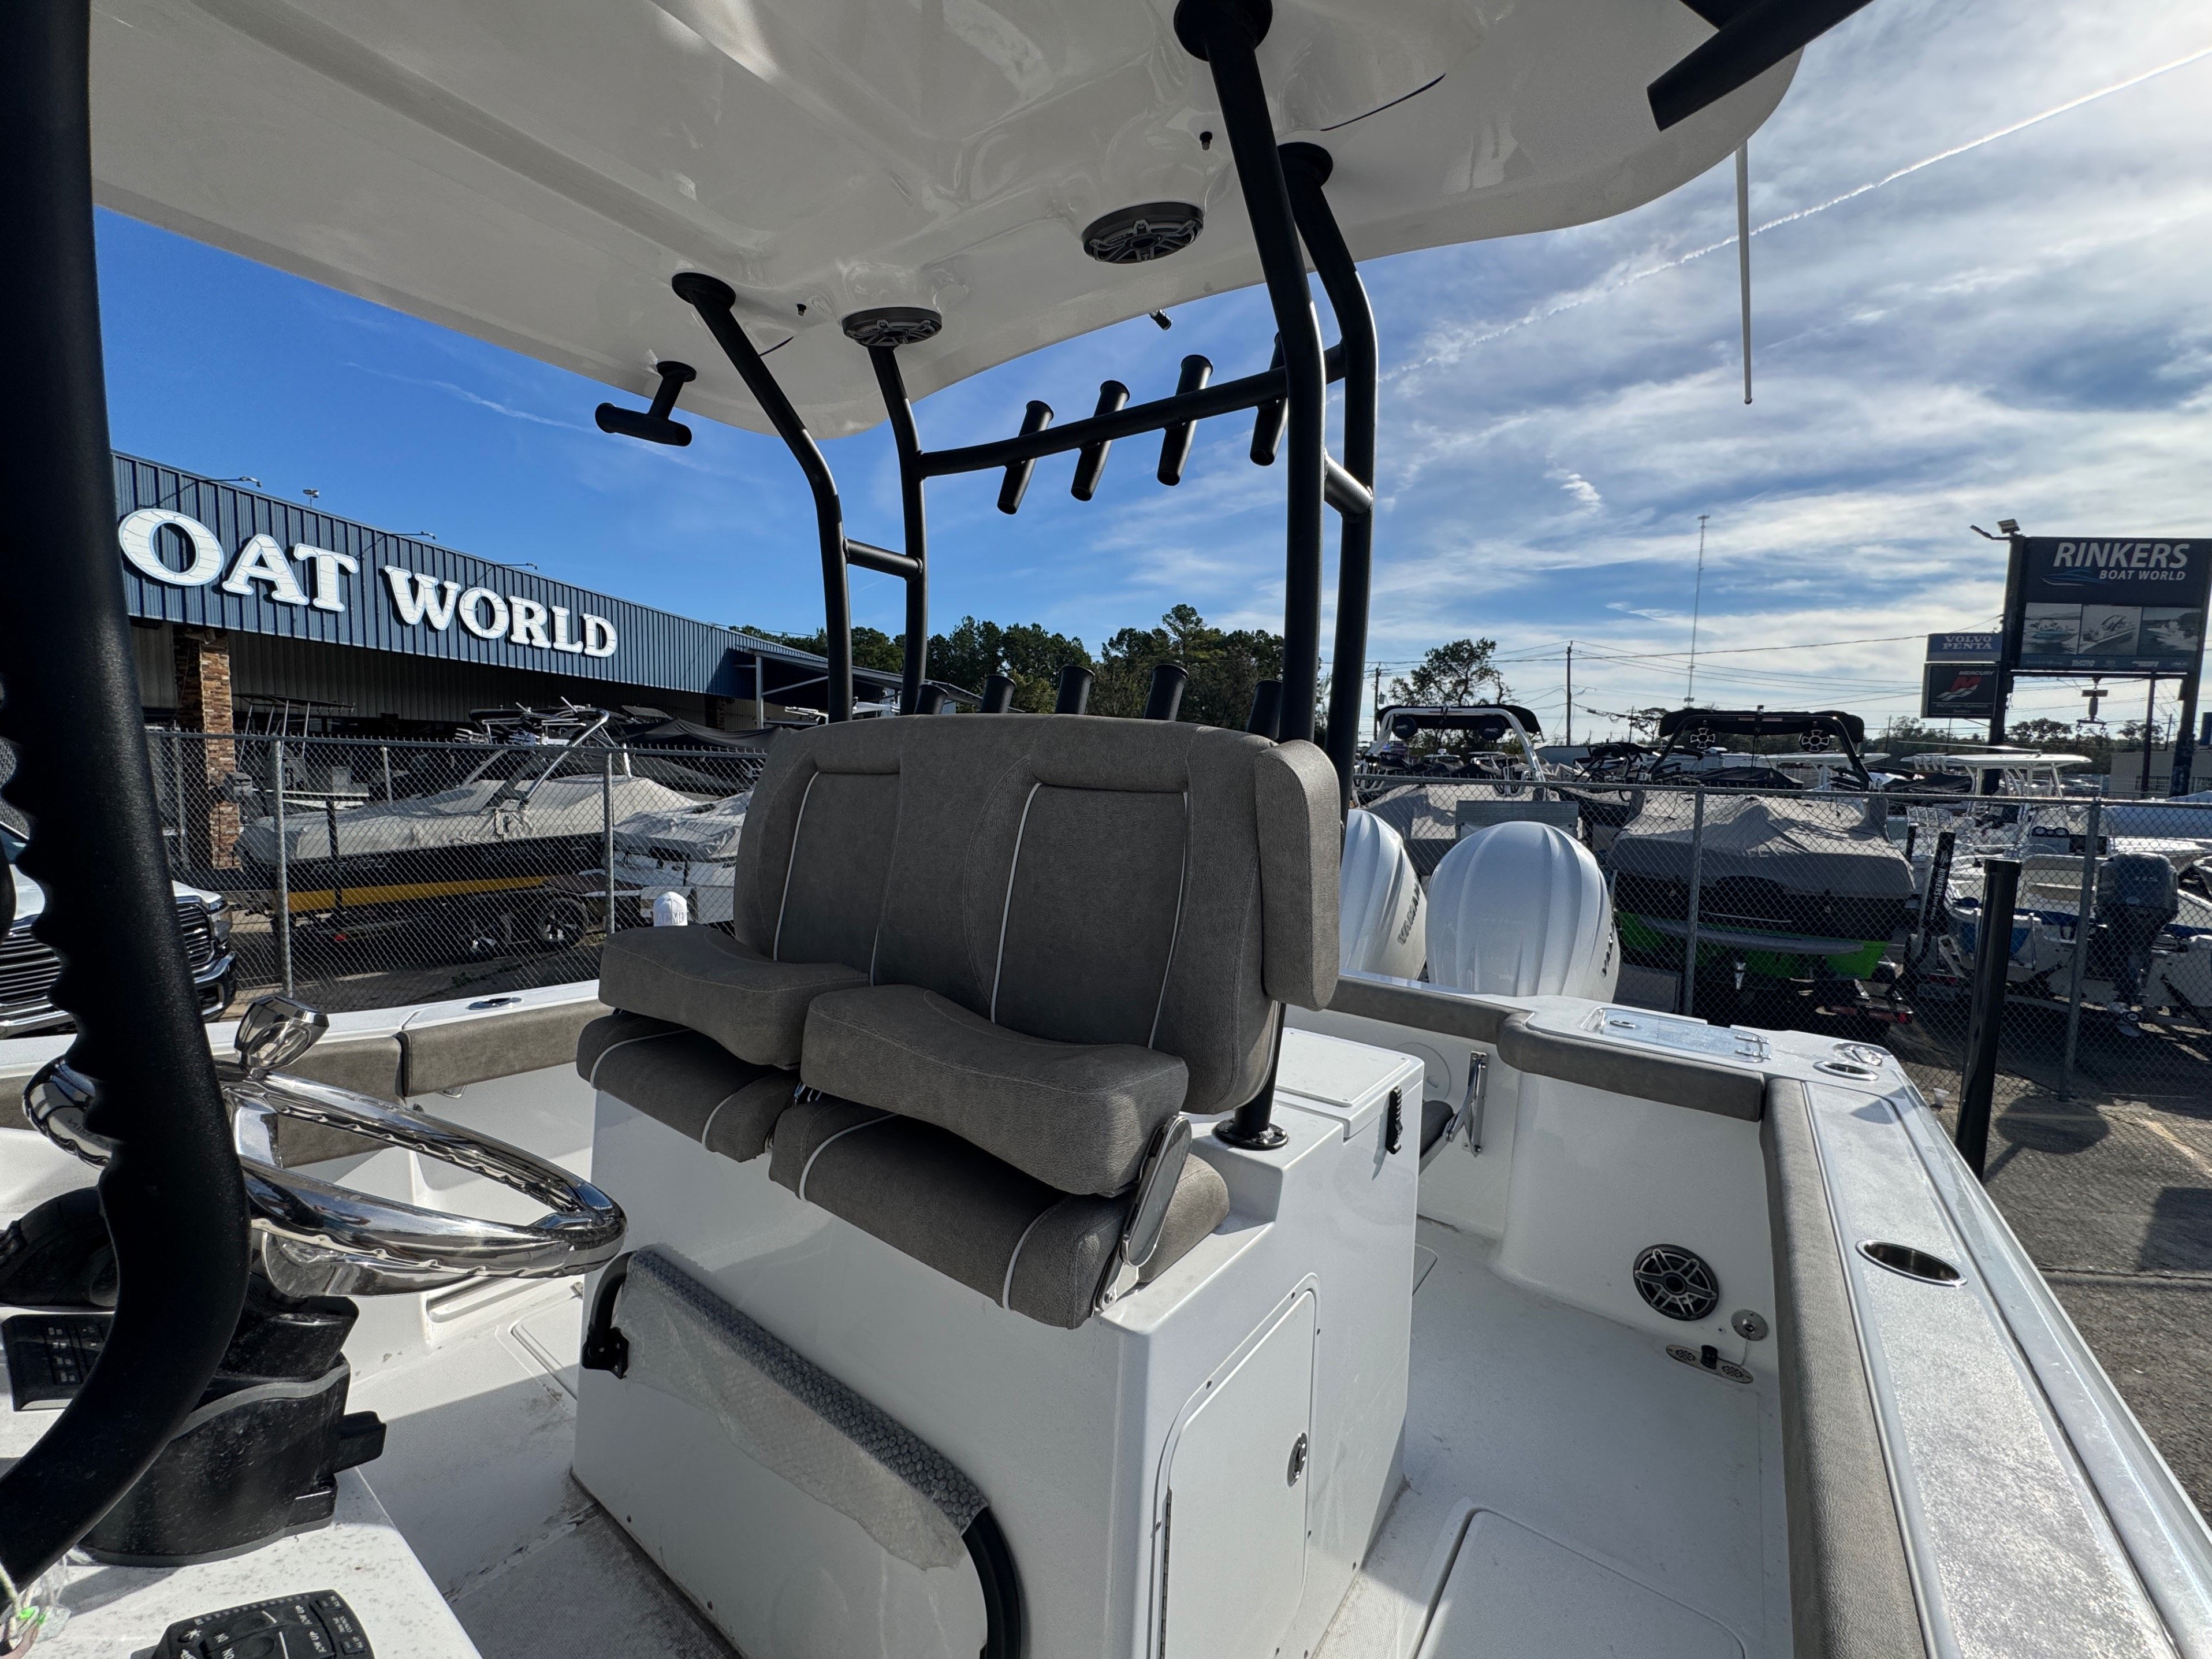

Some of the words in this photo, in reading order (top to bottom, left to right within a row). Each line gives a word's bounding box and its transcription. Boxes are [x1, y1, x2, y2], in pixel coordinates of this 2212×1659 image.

[2053, 542, 2190, 568] RINKERS
[2099, 570, 2135, 579] BOAT
[2139, 571, 2186, 581] WORLD
[383, 564, 617, 658] WORLD
[1934, 868, 1946, 897] RINKERS
[1397, 880, 1421, 945] YAMAH
[295, 1605, 306, 1614] UP
[310, 1631, 320, 1641] UP
